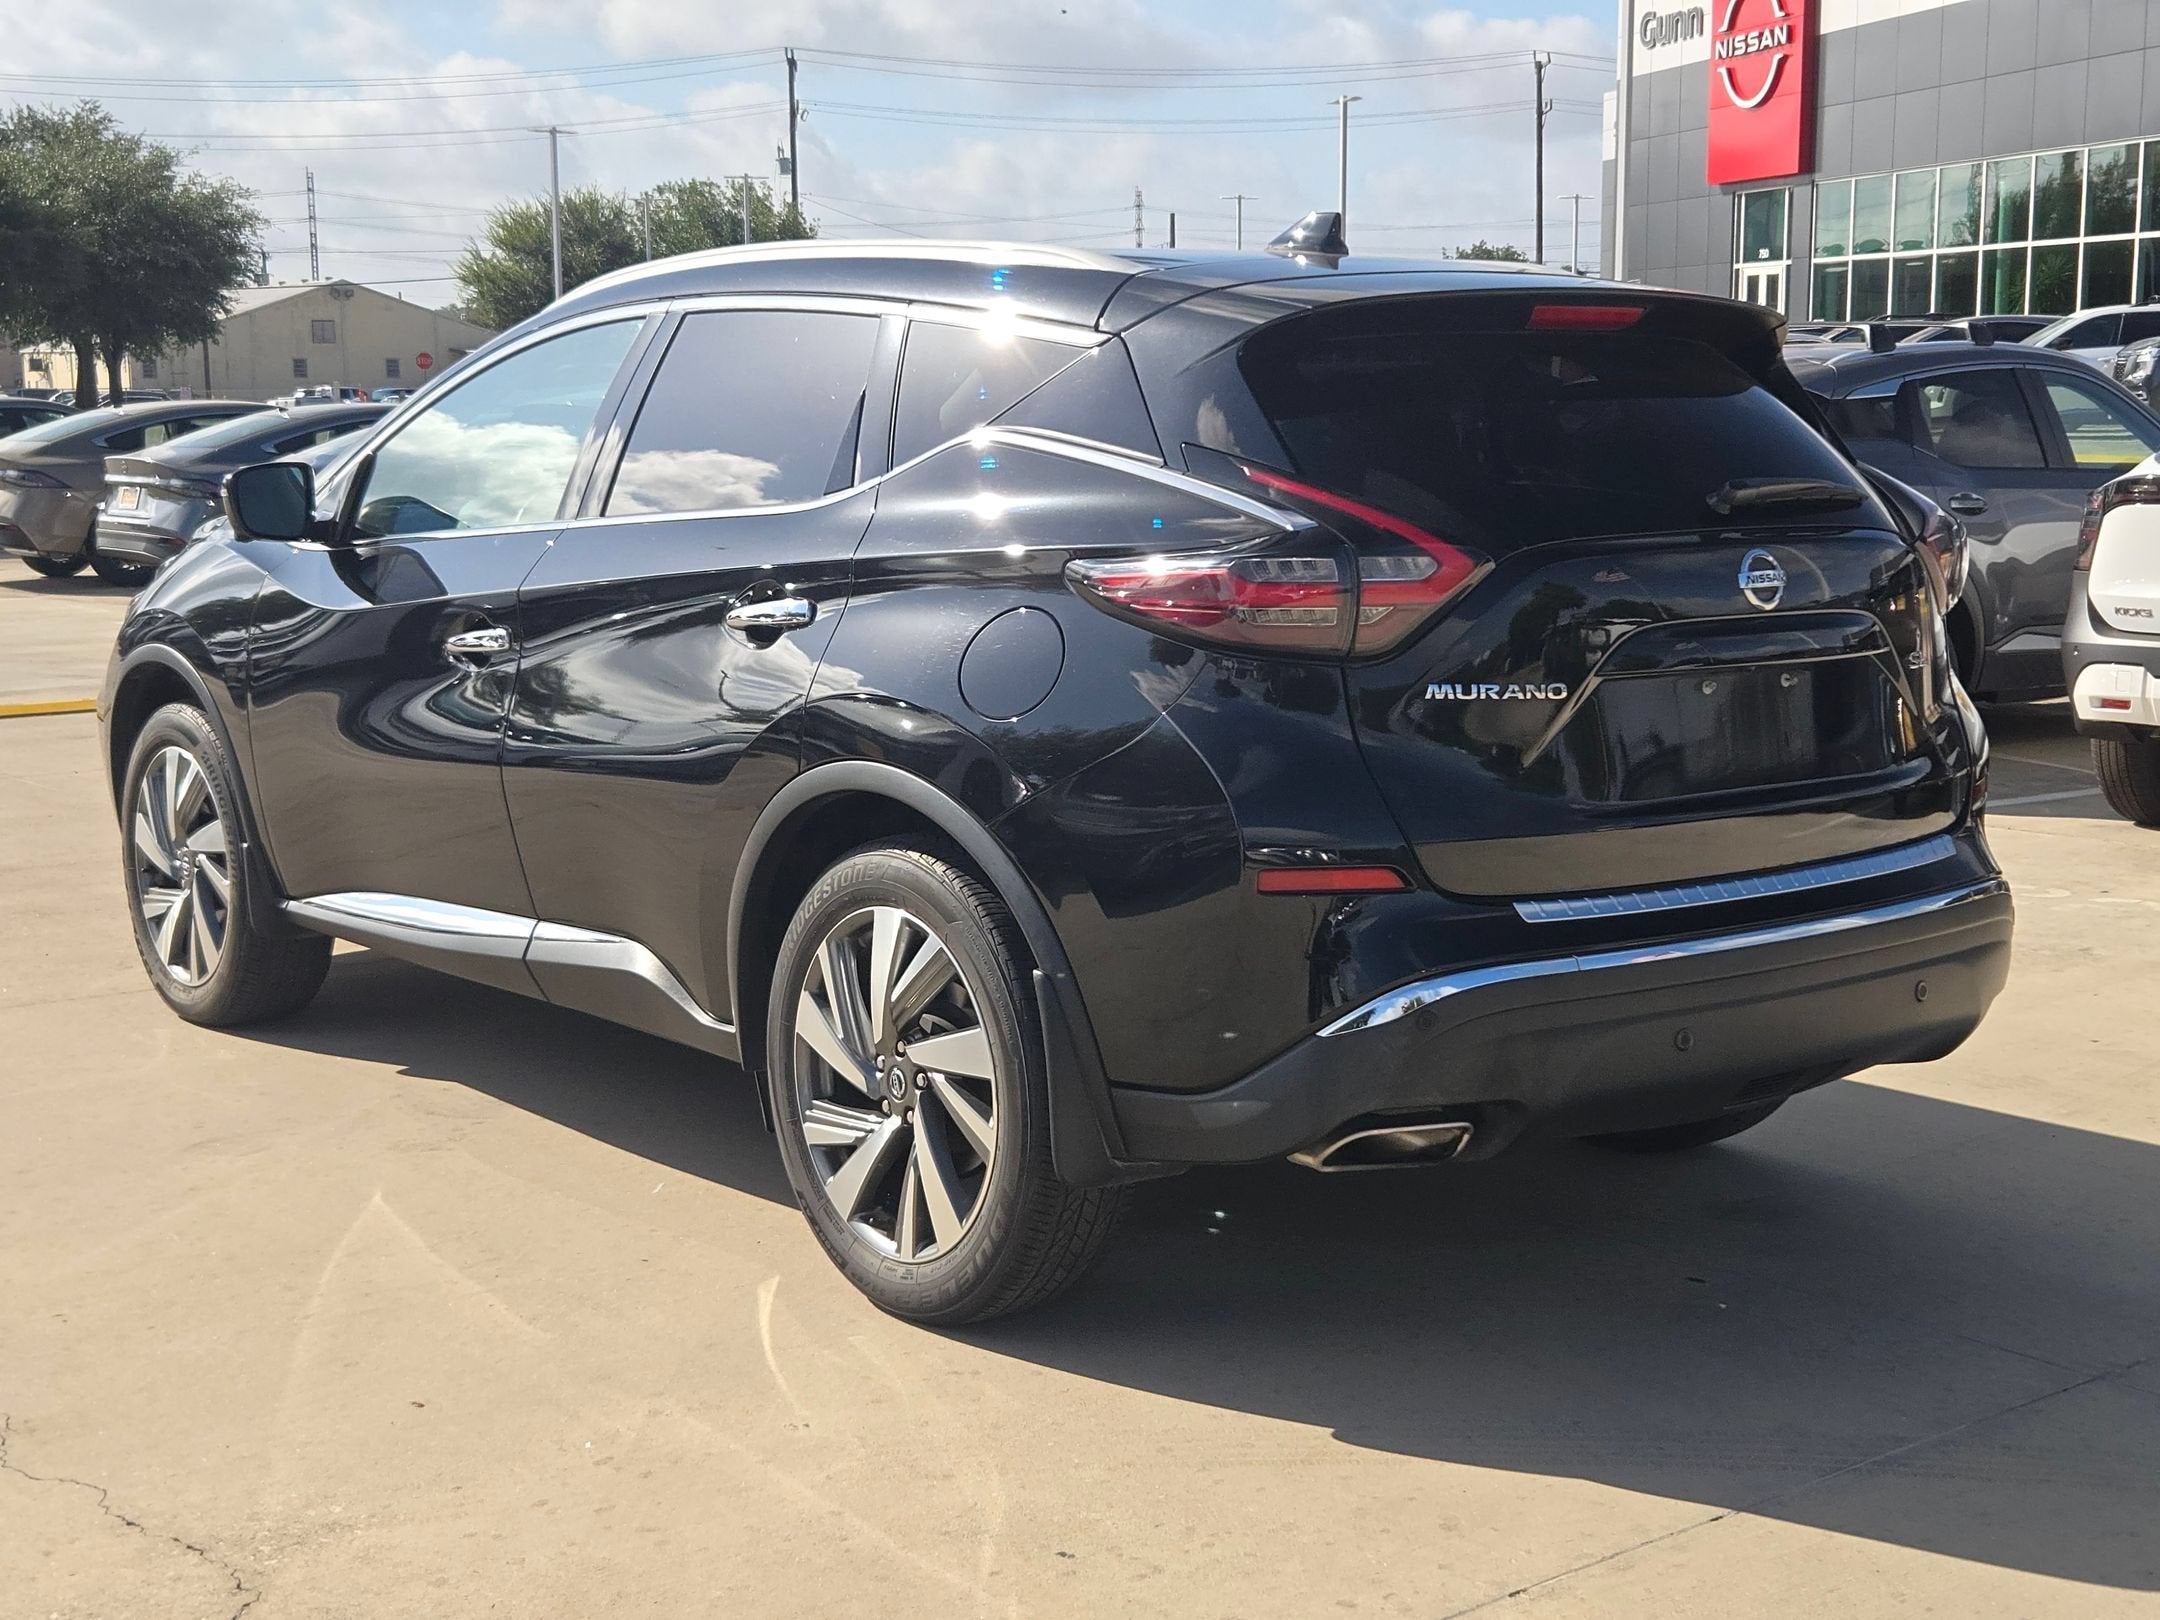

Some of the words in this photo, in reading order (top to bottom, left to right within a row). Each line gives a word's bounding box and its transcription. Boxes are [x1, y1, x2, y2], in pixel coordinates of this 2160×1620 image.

[1640, 6, 1704, 49] Gunn
[1715, 24, 1788, 60] NISSAN
[1747, 572, 1786, 584] NISSAN
[2114, 606, 2154, 618] KICKS
[1425, 682, 1568, 700] MURANO
